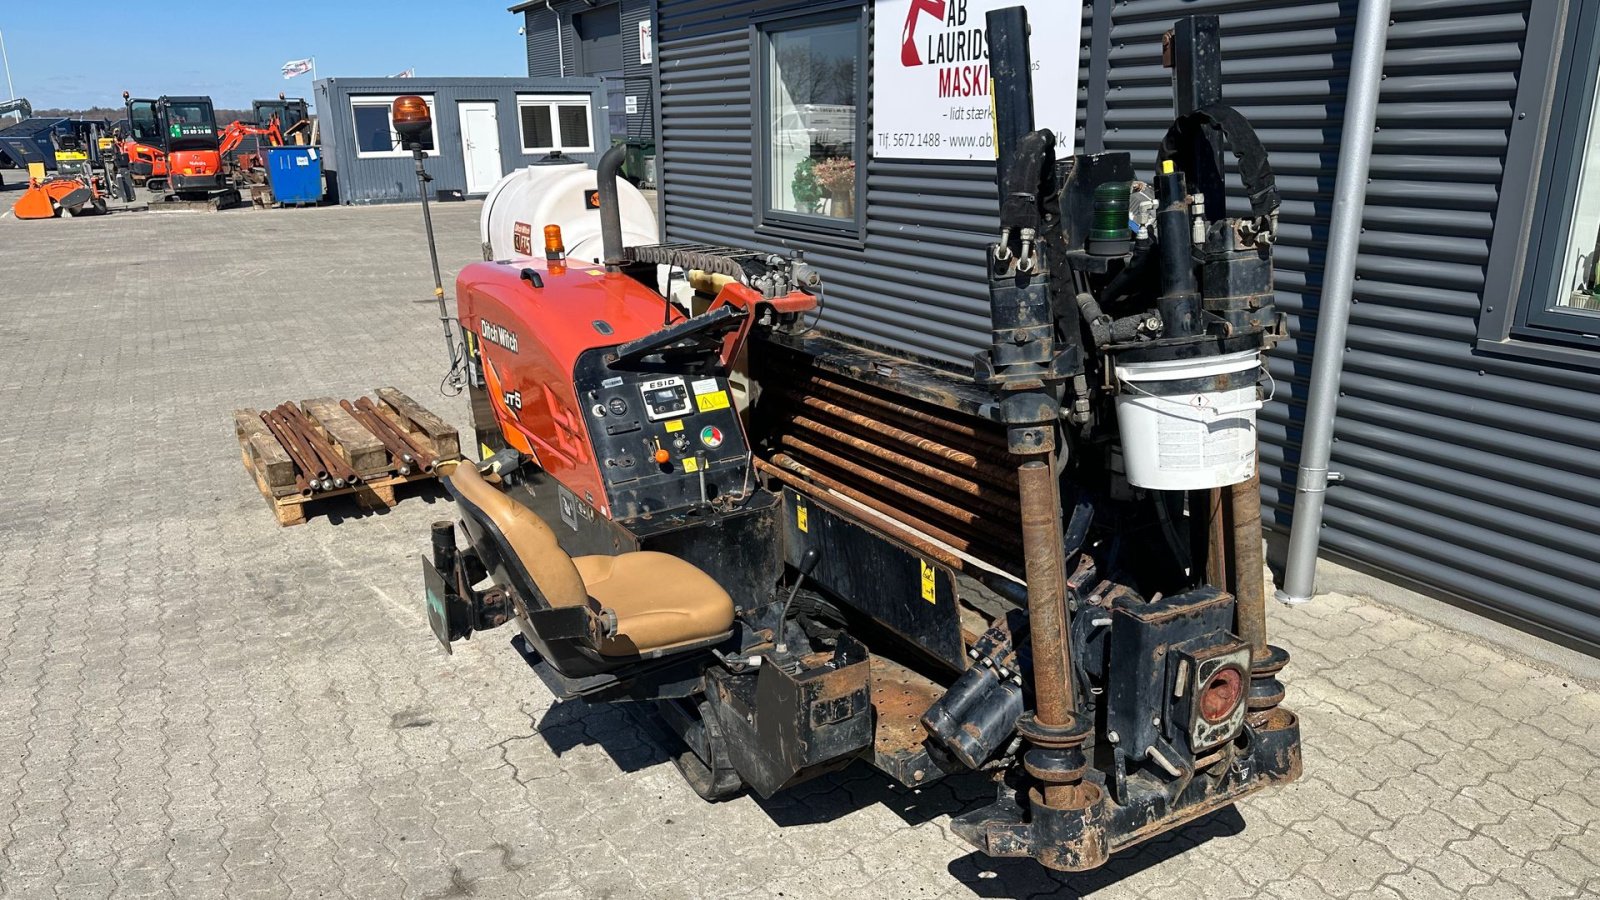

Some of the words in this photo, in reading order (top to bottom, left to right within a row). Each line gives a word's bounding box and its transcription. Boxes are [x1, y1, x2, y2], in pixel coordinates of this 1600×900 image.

[947, 0, 967, 27] AB
[938, 65, 992, 98] MASKI
[950, 106, 964, 120] lidt
[878, 133, 891, 149] Tlf.
[949, 132, 993, 147] www.ab
[481, 319, 498, 344] Ditch
[498, 327, 518, 353] Witch
[650, 380, 675, 389] ESID
